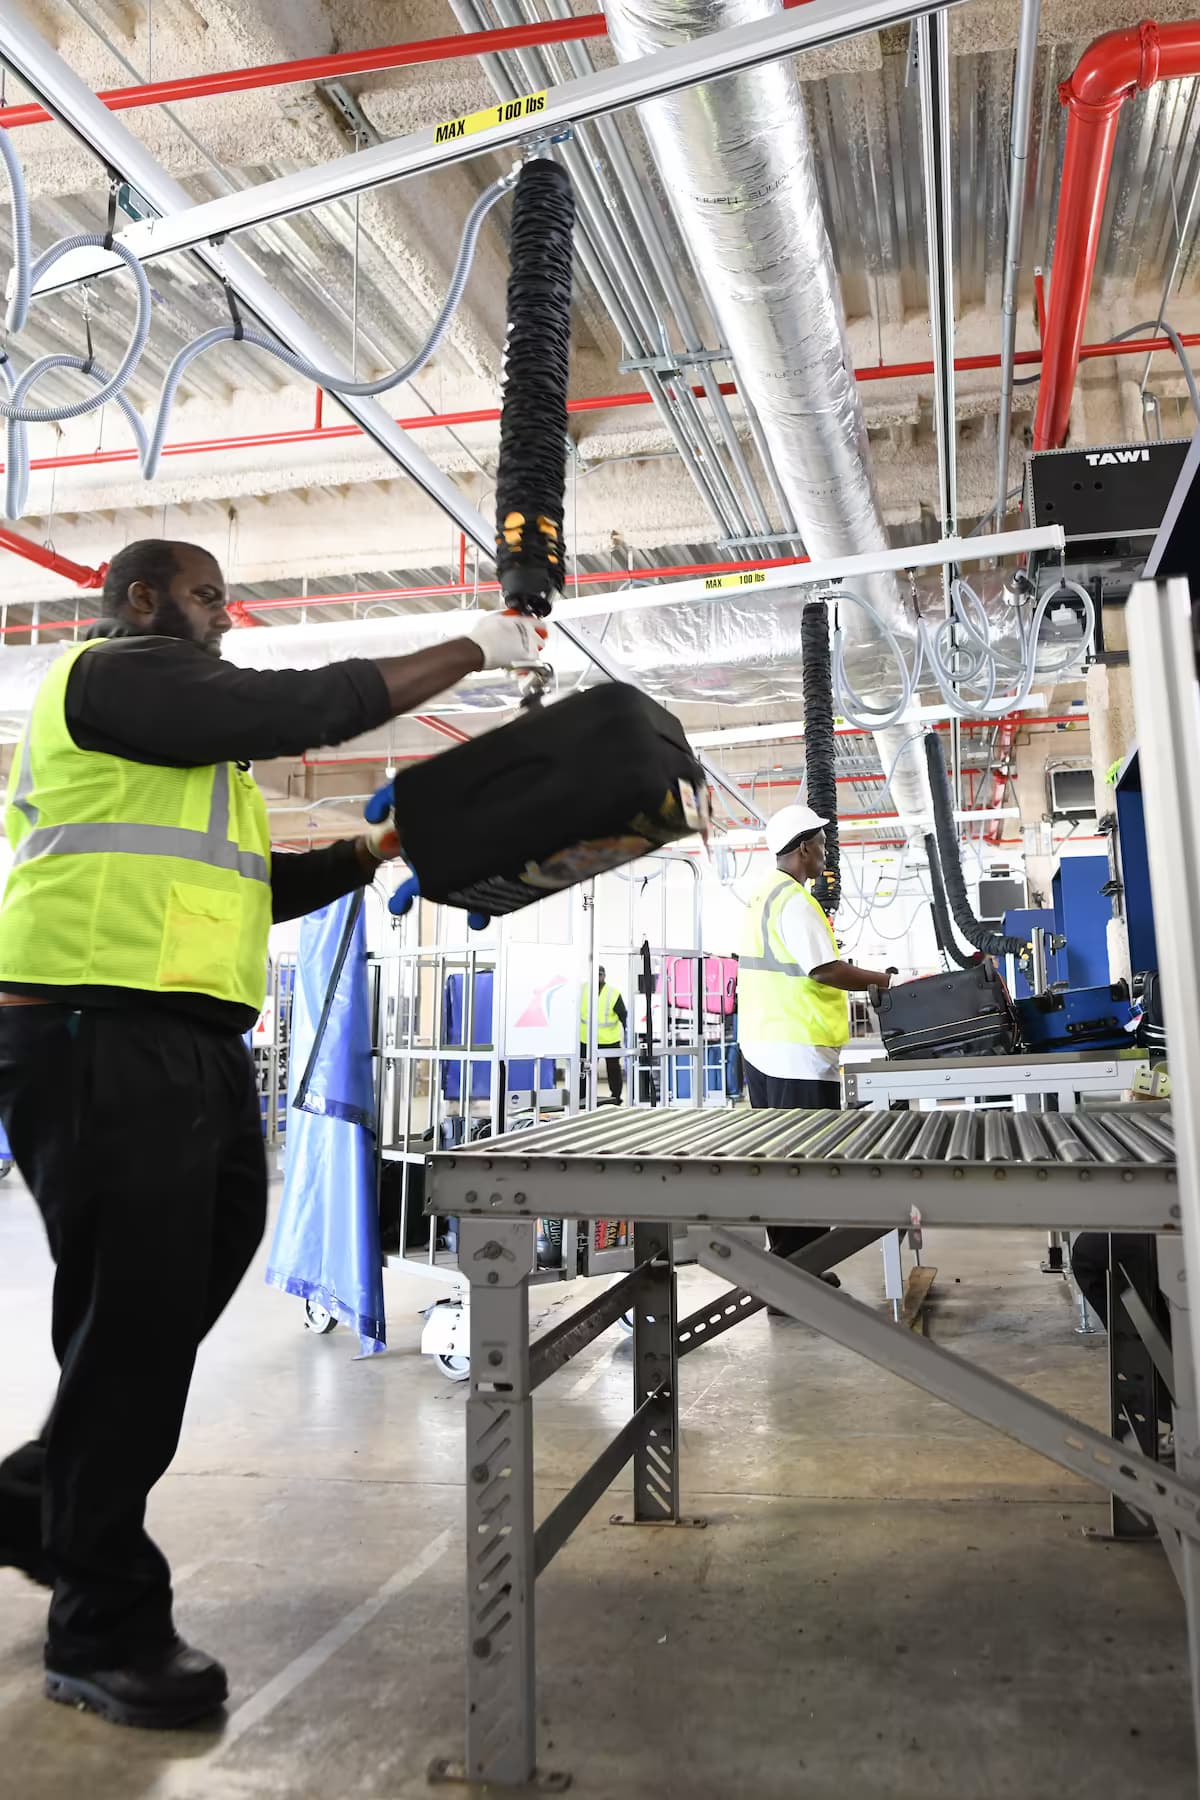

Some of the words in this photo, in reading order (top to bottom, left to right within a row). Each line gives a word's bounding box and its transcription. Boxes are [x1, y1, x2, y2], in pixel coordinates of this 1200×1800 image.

[436, 119, 465, 143] MAX
[497, 101, 521, 122] 100
[525, 97, 544, 114] lbs
[1085, 449, 1150, 466] TAWI
[706, 579, 722, 589] MAX
[739, 575, 752, 584] 100
[755, 573, 765, 582] lbs
